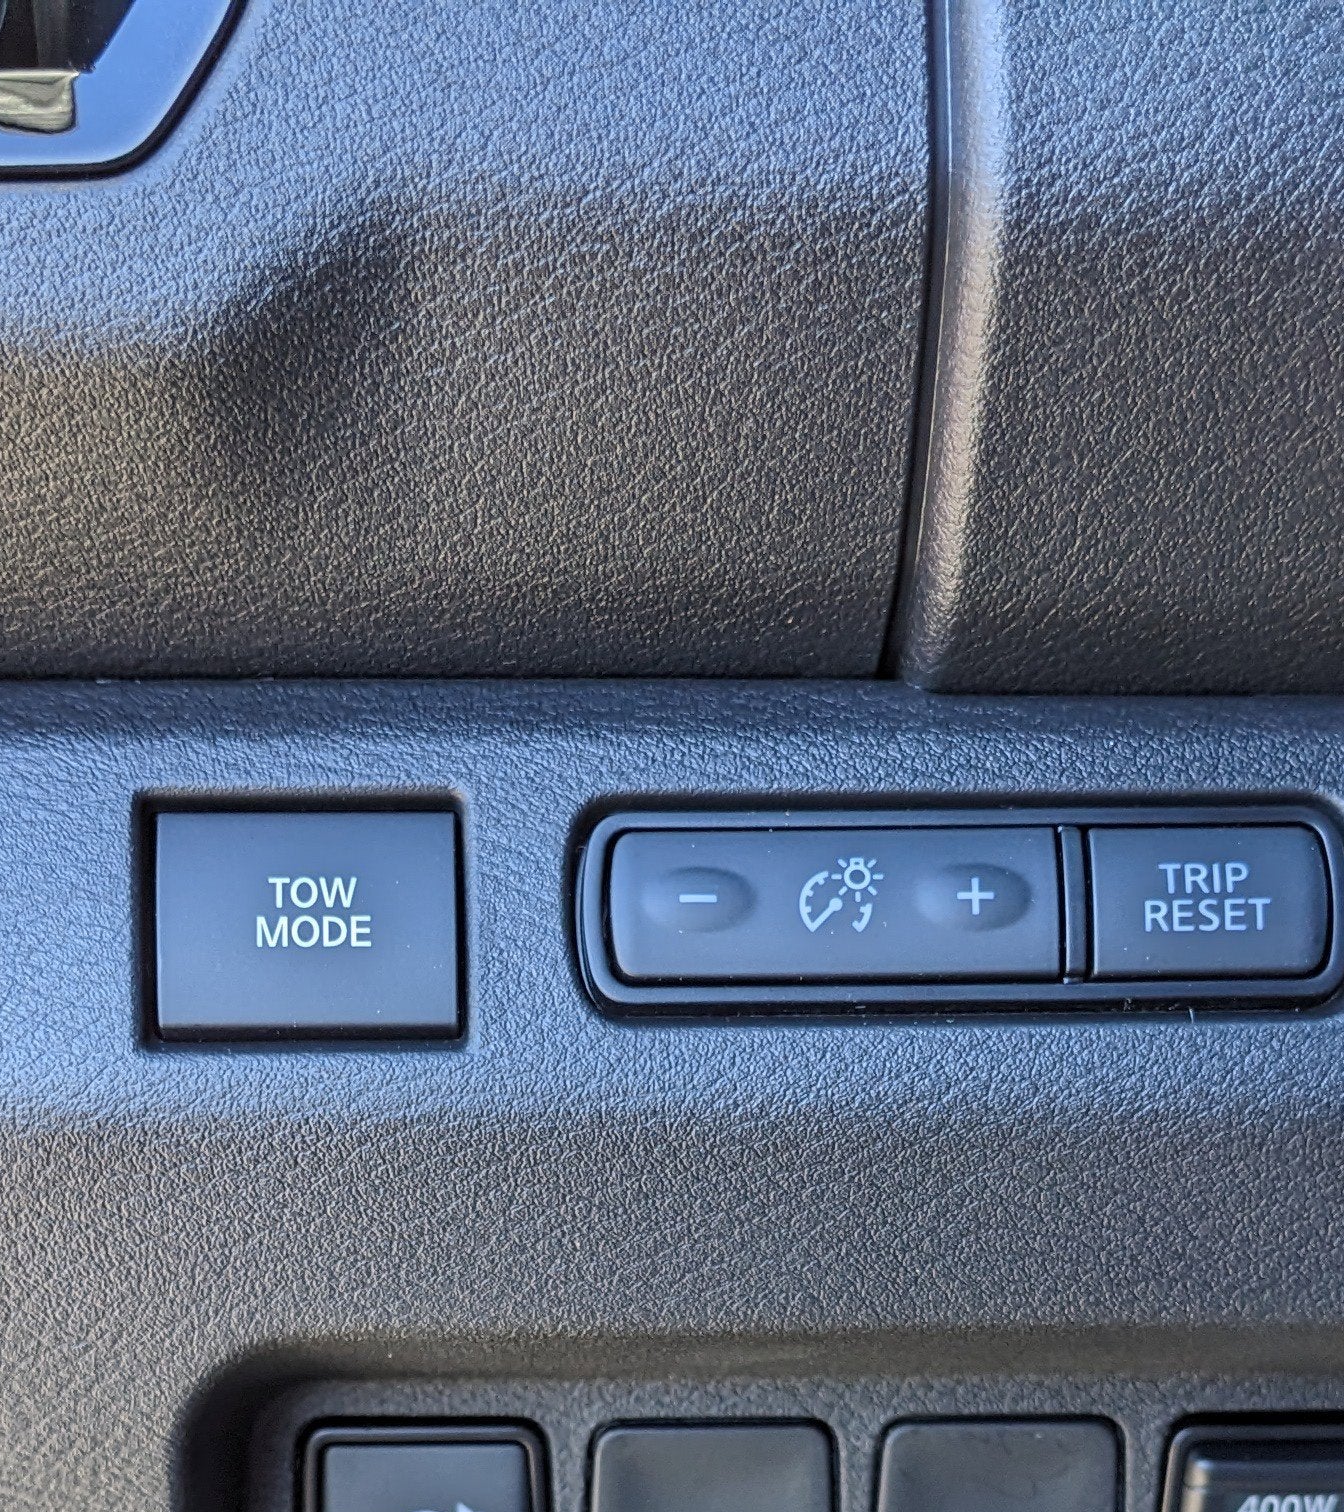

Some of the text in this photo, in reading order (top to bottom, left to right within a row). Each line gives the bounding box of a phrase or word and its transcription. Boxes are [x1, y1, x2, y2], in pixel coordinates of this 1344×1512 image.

[268, 876, 357, 909] TOW
[1158, 862, 1249, 894] TRIP
[256, 915, 372, 948] MODE
[1144, 898, 1272, 932] RESET
